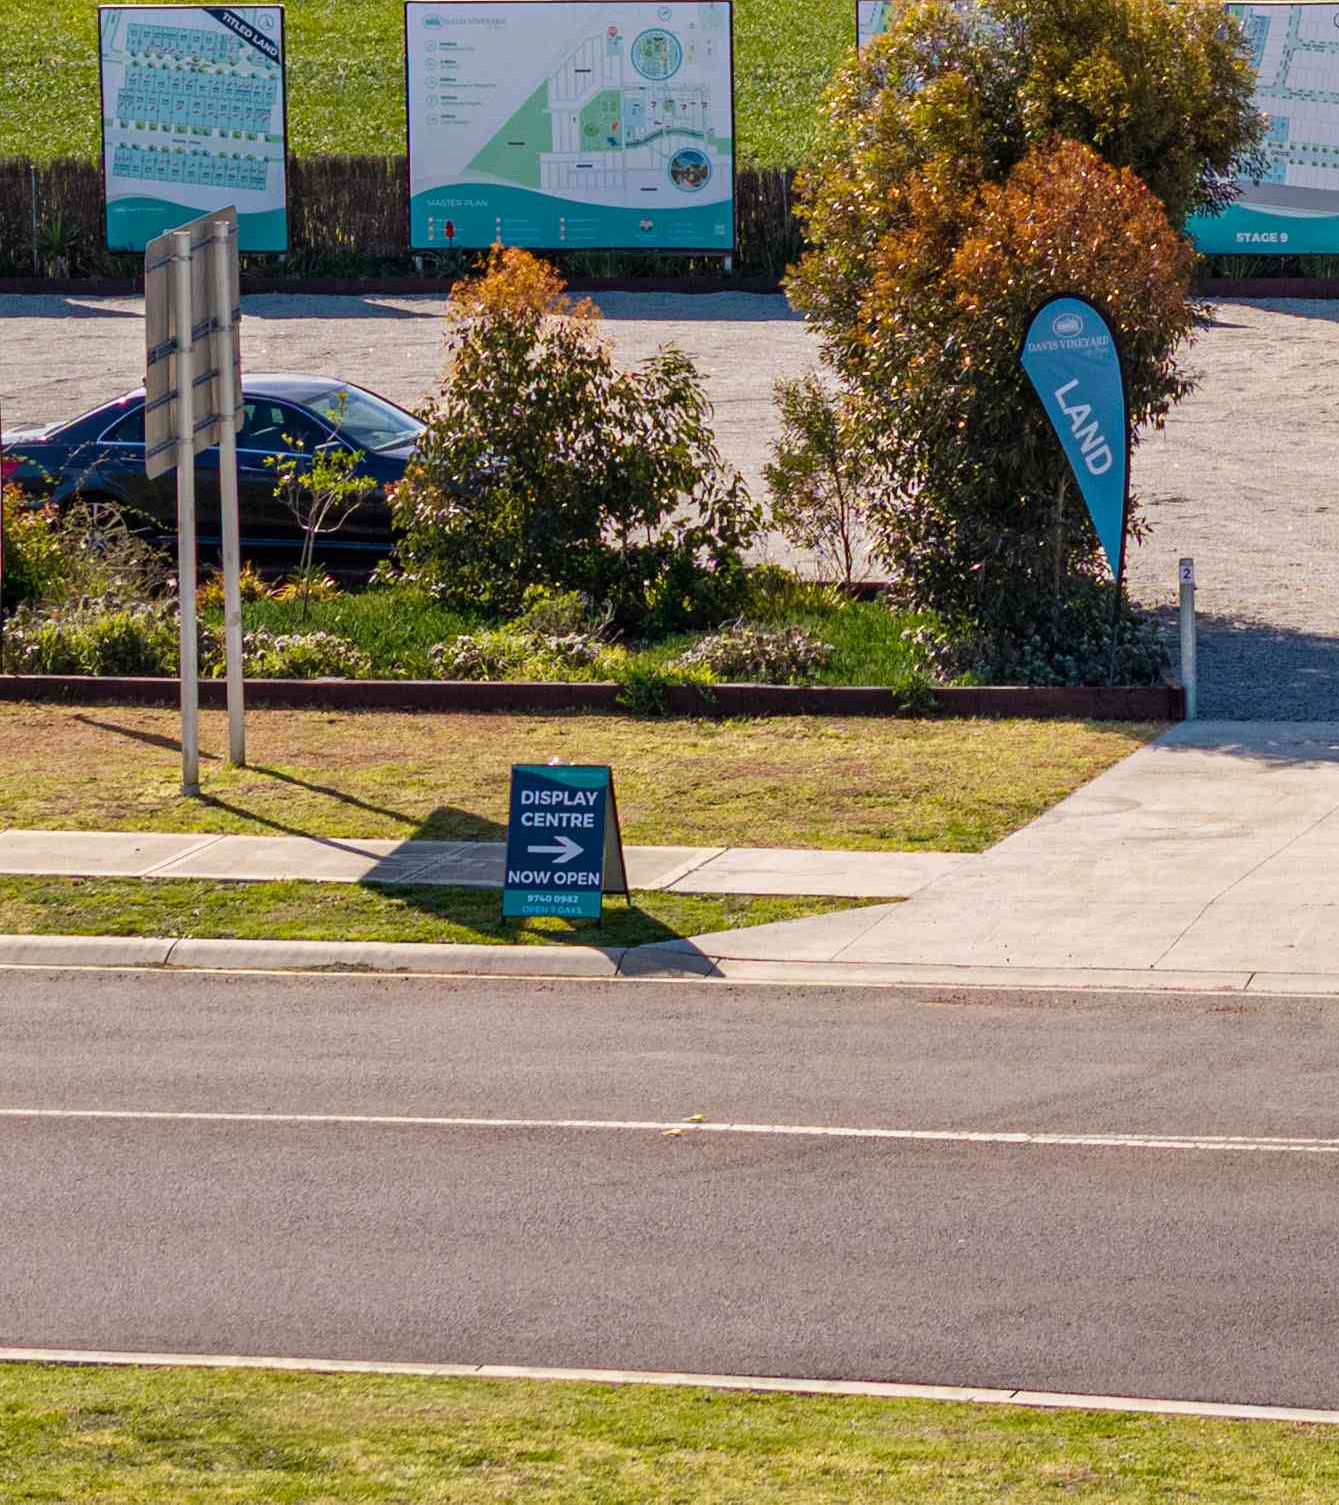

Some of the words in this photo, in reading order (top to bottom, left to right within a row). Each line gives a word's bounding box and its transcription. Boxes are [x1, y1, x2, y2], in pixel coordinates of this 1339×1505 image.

[222, 12, 253, 38] TITLED
[252, 35, 278, 56] LAND
[426, 198, 462, 208] MASTER
[463, 198, 488, 208] PLAN
[1236, 232, 1278, 243] STAGE
[1028, 341, 1058, 352] DAVIS
[1058, 335, 1109, 349] VINEYARD
[1054, 378, 1113, 475] LAND
[521, 790, 598, 805] DISPLAY
[521, 812, 595, 828] CENTRE
[507, 870, 552, 884] NOW
[553, 871, 600, 886] OPEN
